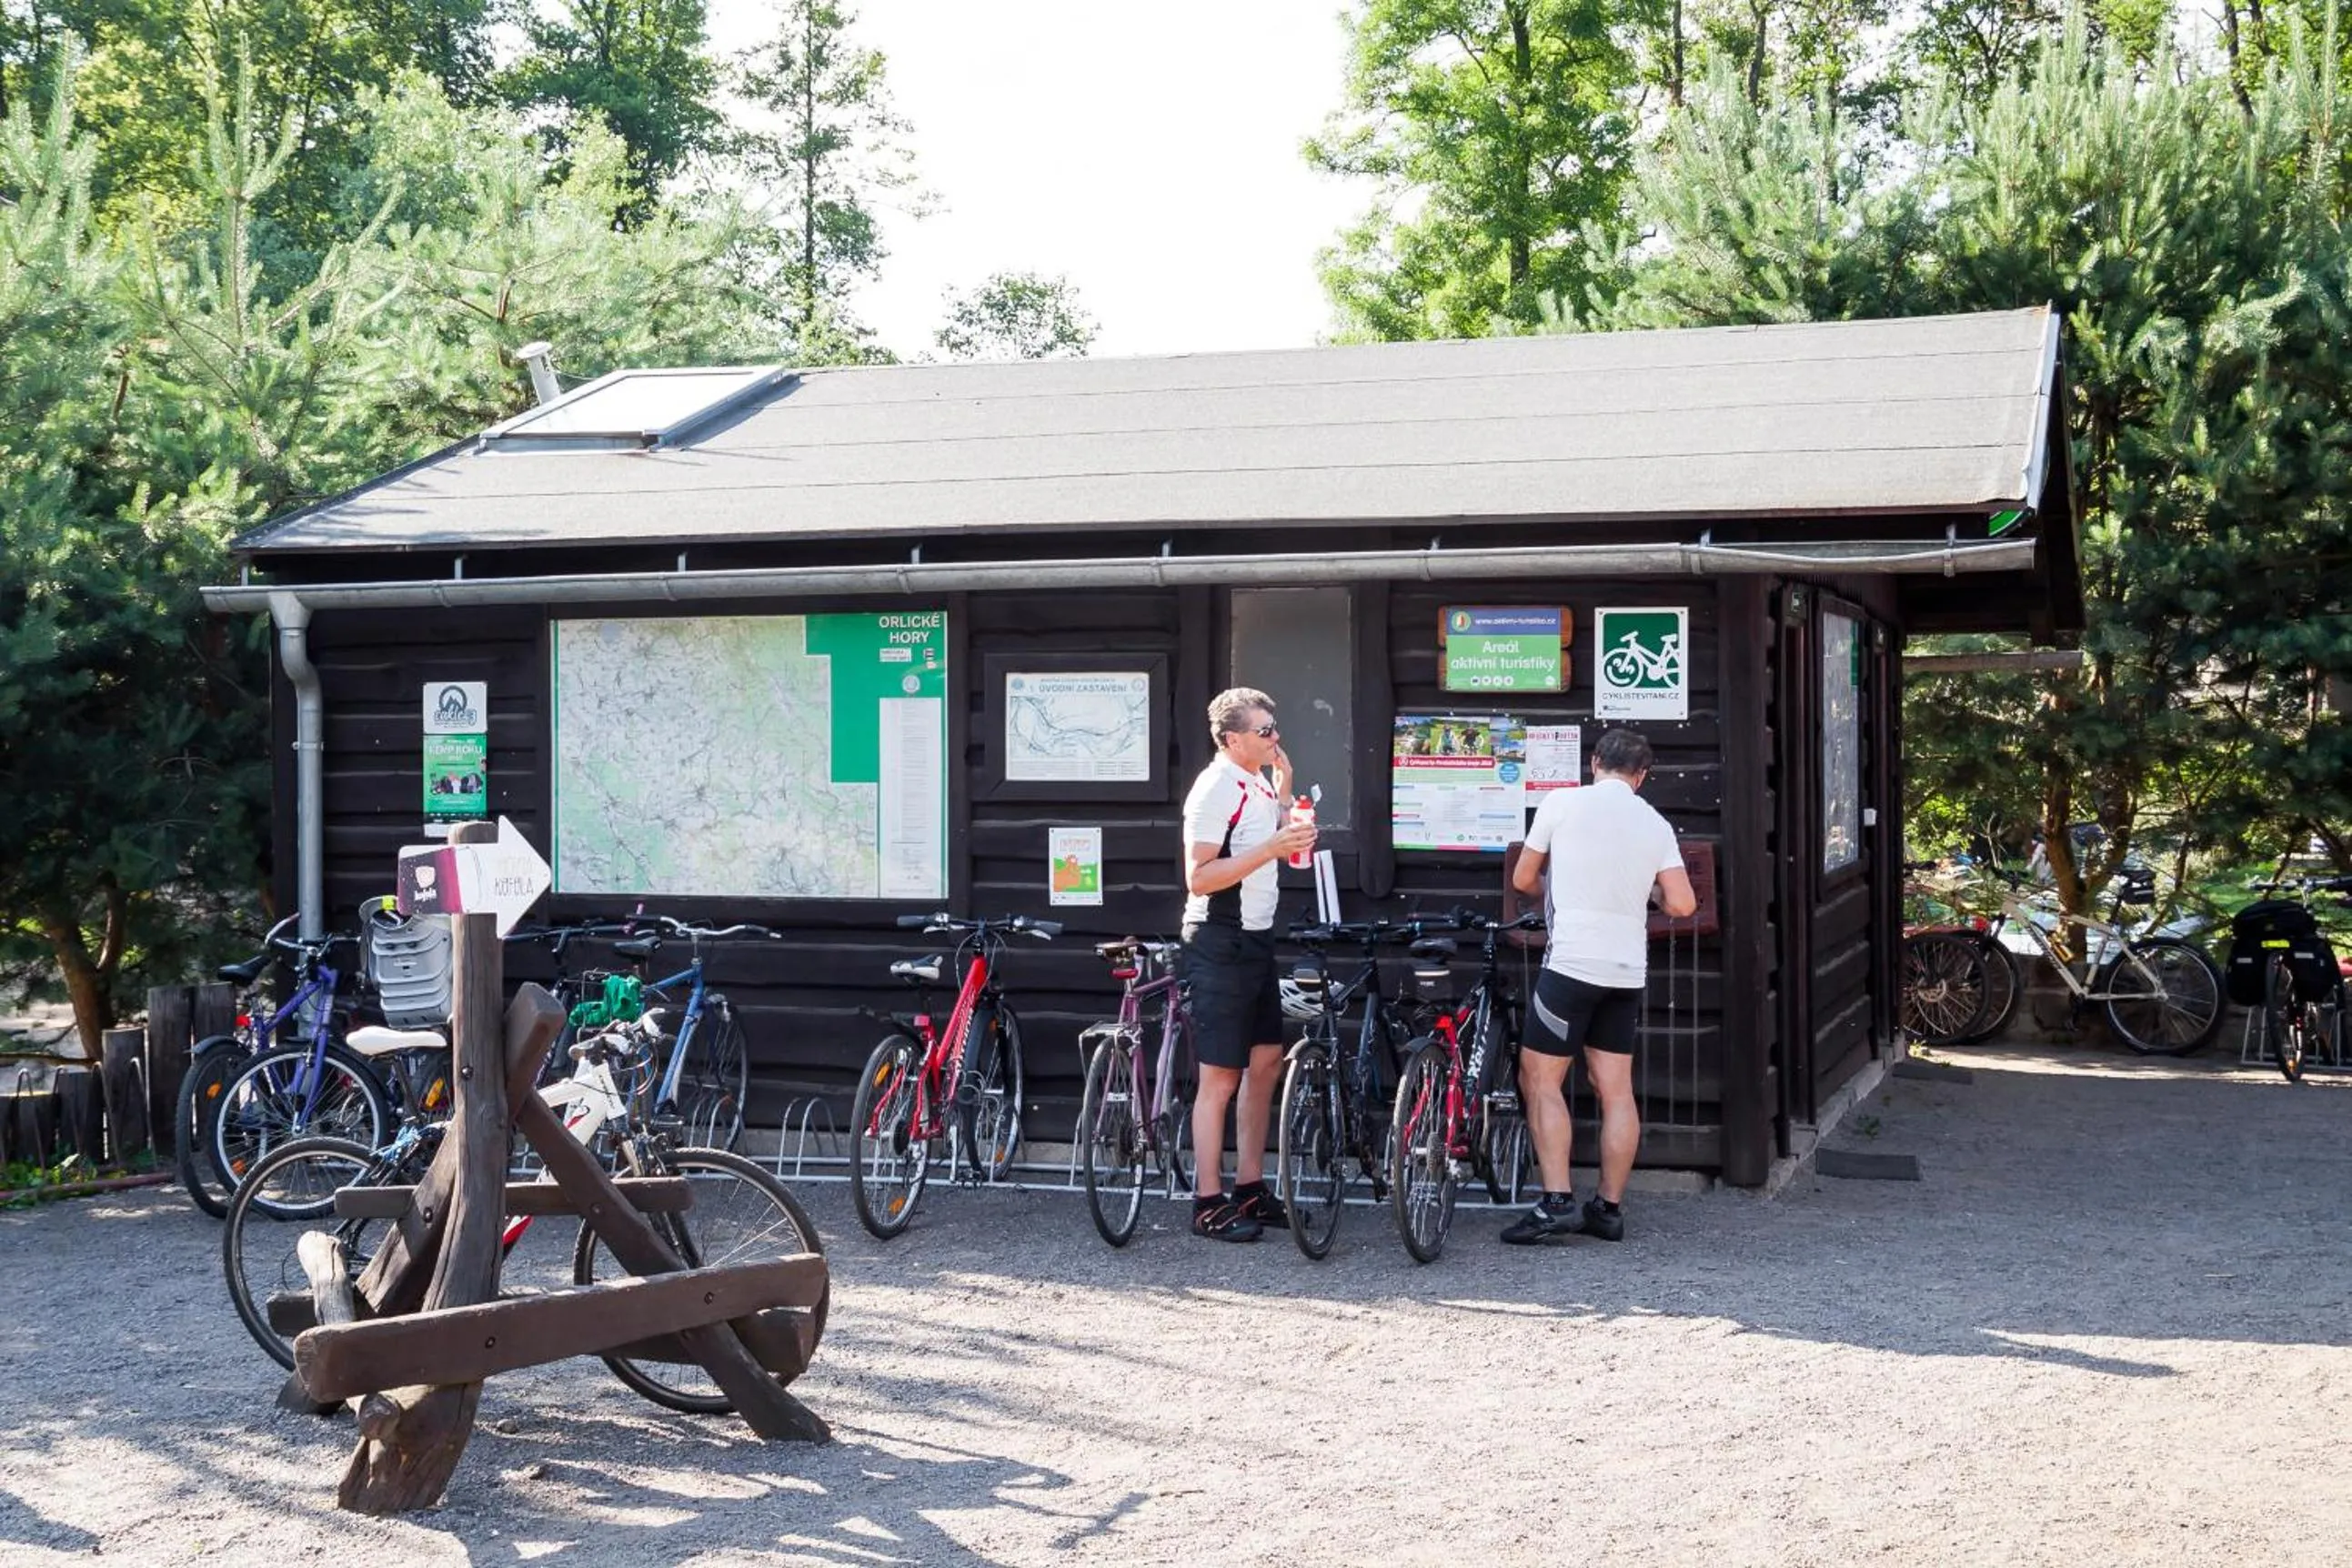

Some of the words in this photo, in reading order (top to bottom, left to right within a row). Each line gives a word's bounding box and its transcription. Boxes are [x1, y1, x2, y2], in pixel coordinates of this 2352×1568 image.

[879, 615, 940, 628] ORLICKÉ
[890, 631, 930, 644] HORY
[1483, 639, 1520, 653] Areál
[1451, 656, 1498, 670] aktivní
[1502, 656, 1556, 672] turistiky
